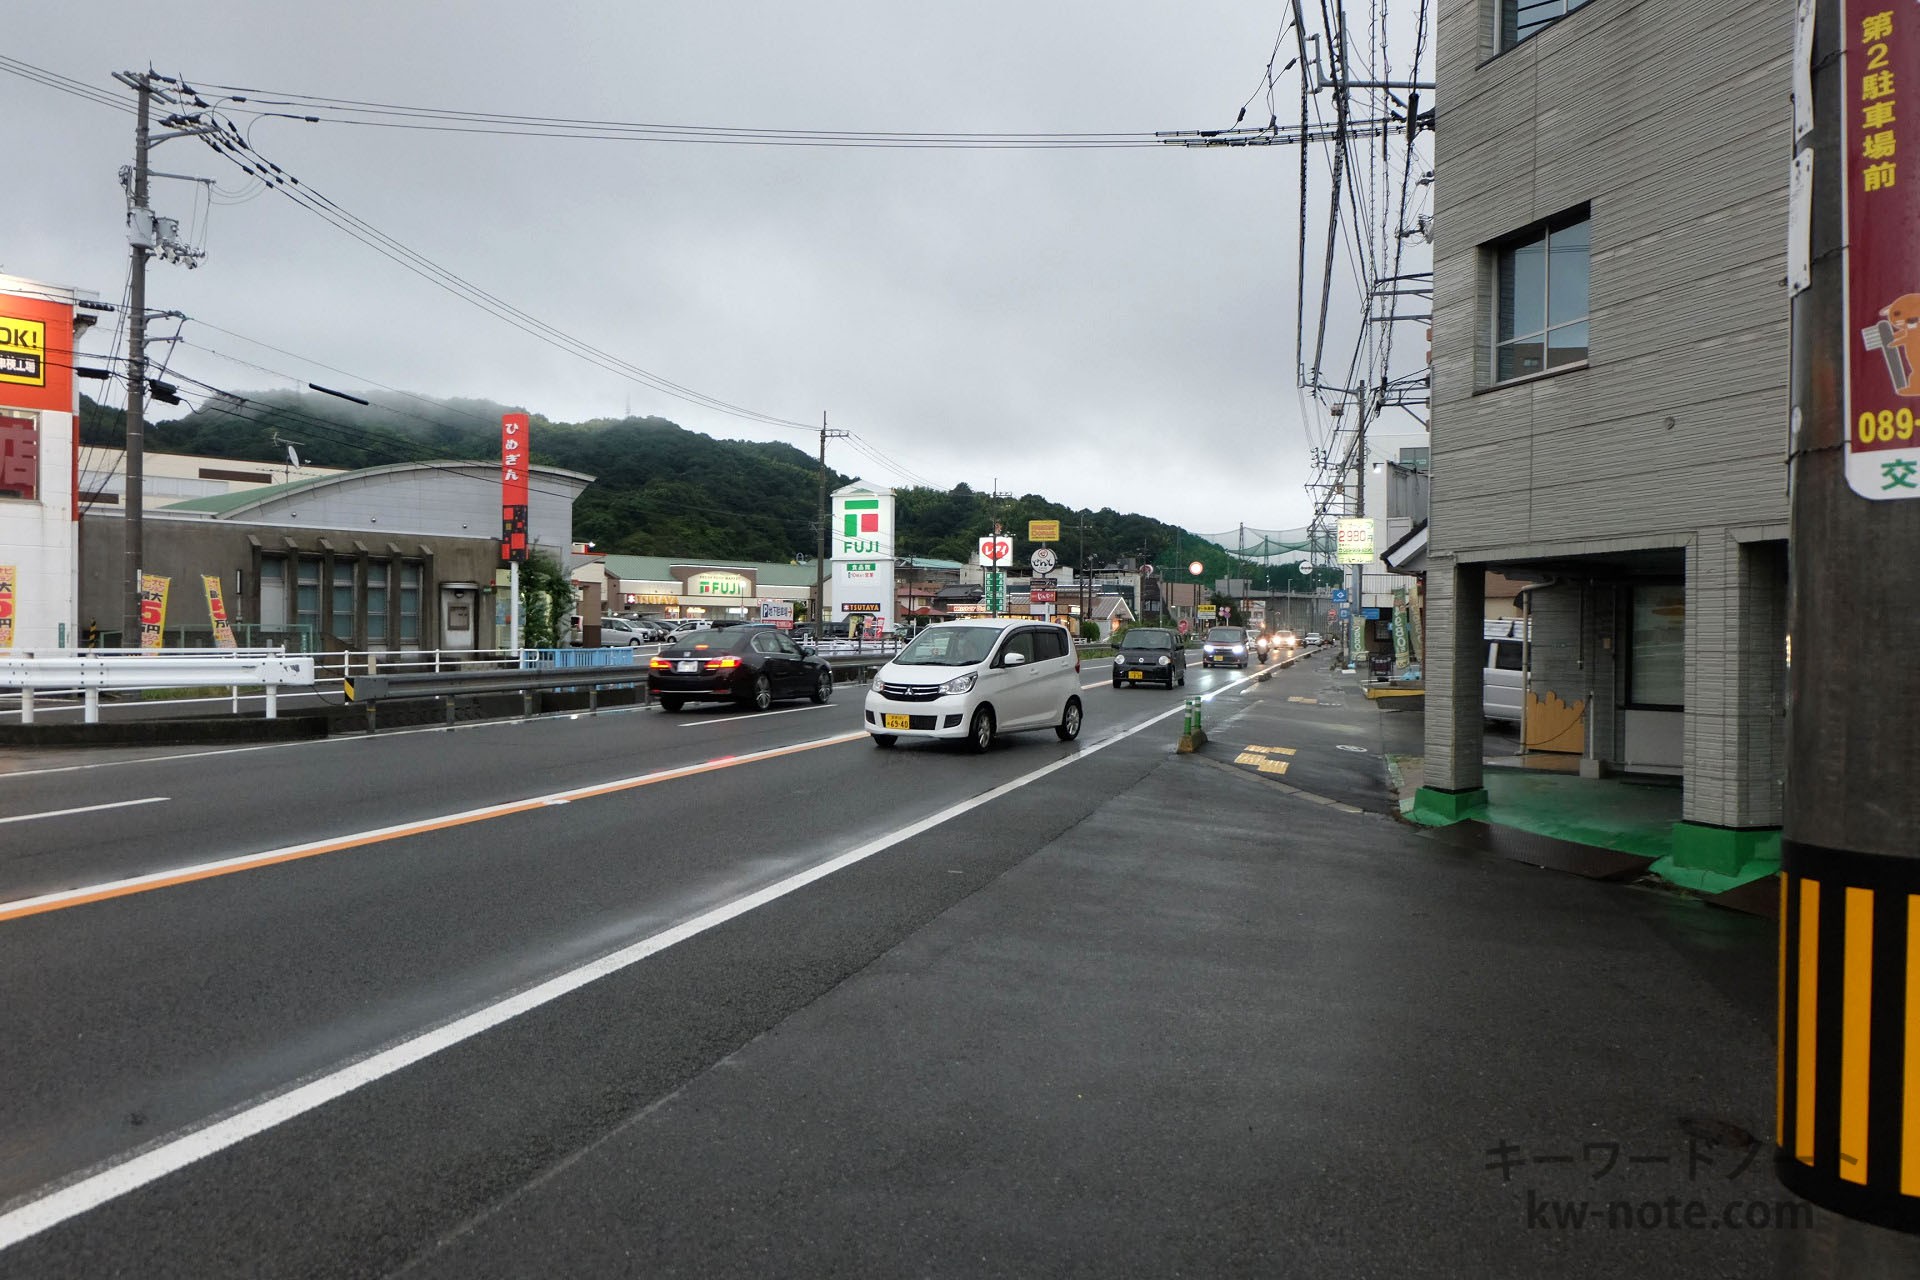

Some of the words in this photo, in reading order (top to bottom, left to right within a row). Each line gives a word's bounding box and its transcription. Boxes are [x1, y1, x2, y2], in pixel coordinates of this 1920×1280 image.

[1861, 10, 1896, 192] 第2駐車場前
[504, 422, 520, 481] ひめぎん
[1881, 458, 1918, 491] 交
[843, 540, 880, 554] FUJI
[637, 594, 679, 605] TSUTAYA
[712, 582, 740, 595] FUJI
[141, 600, 162, 624] 5
